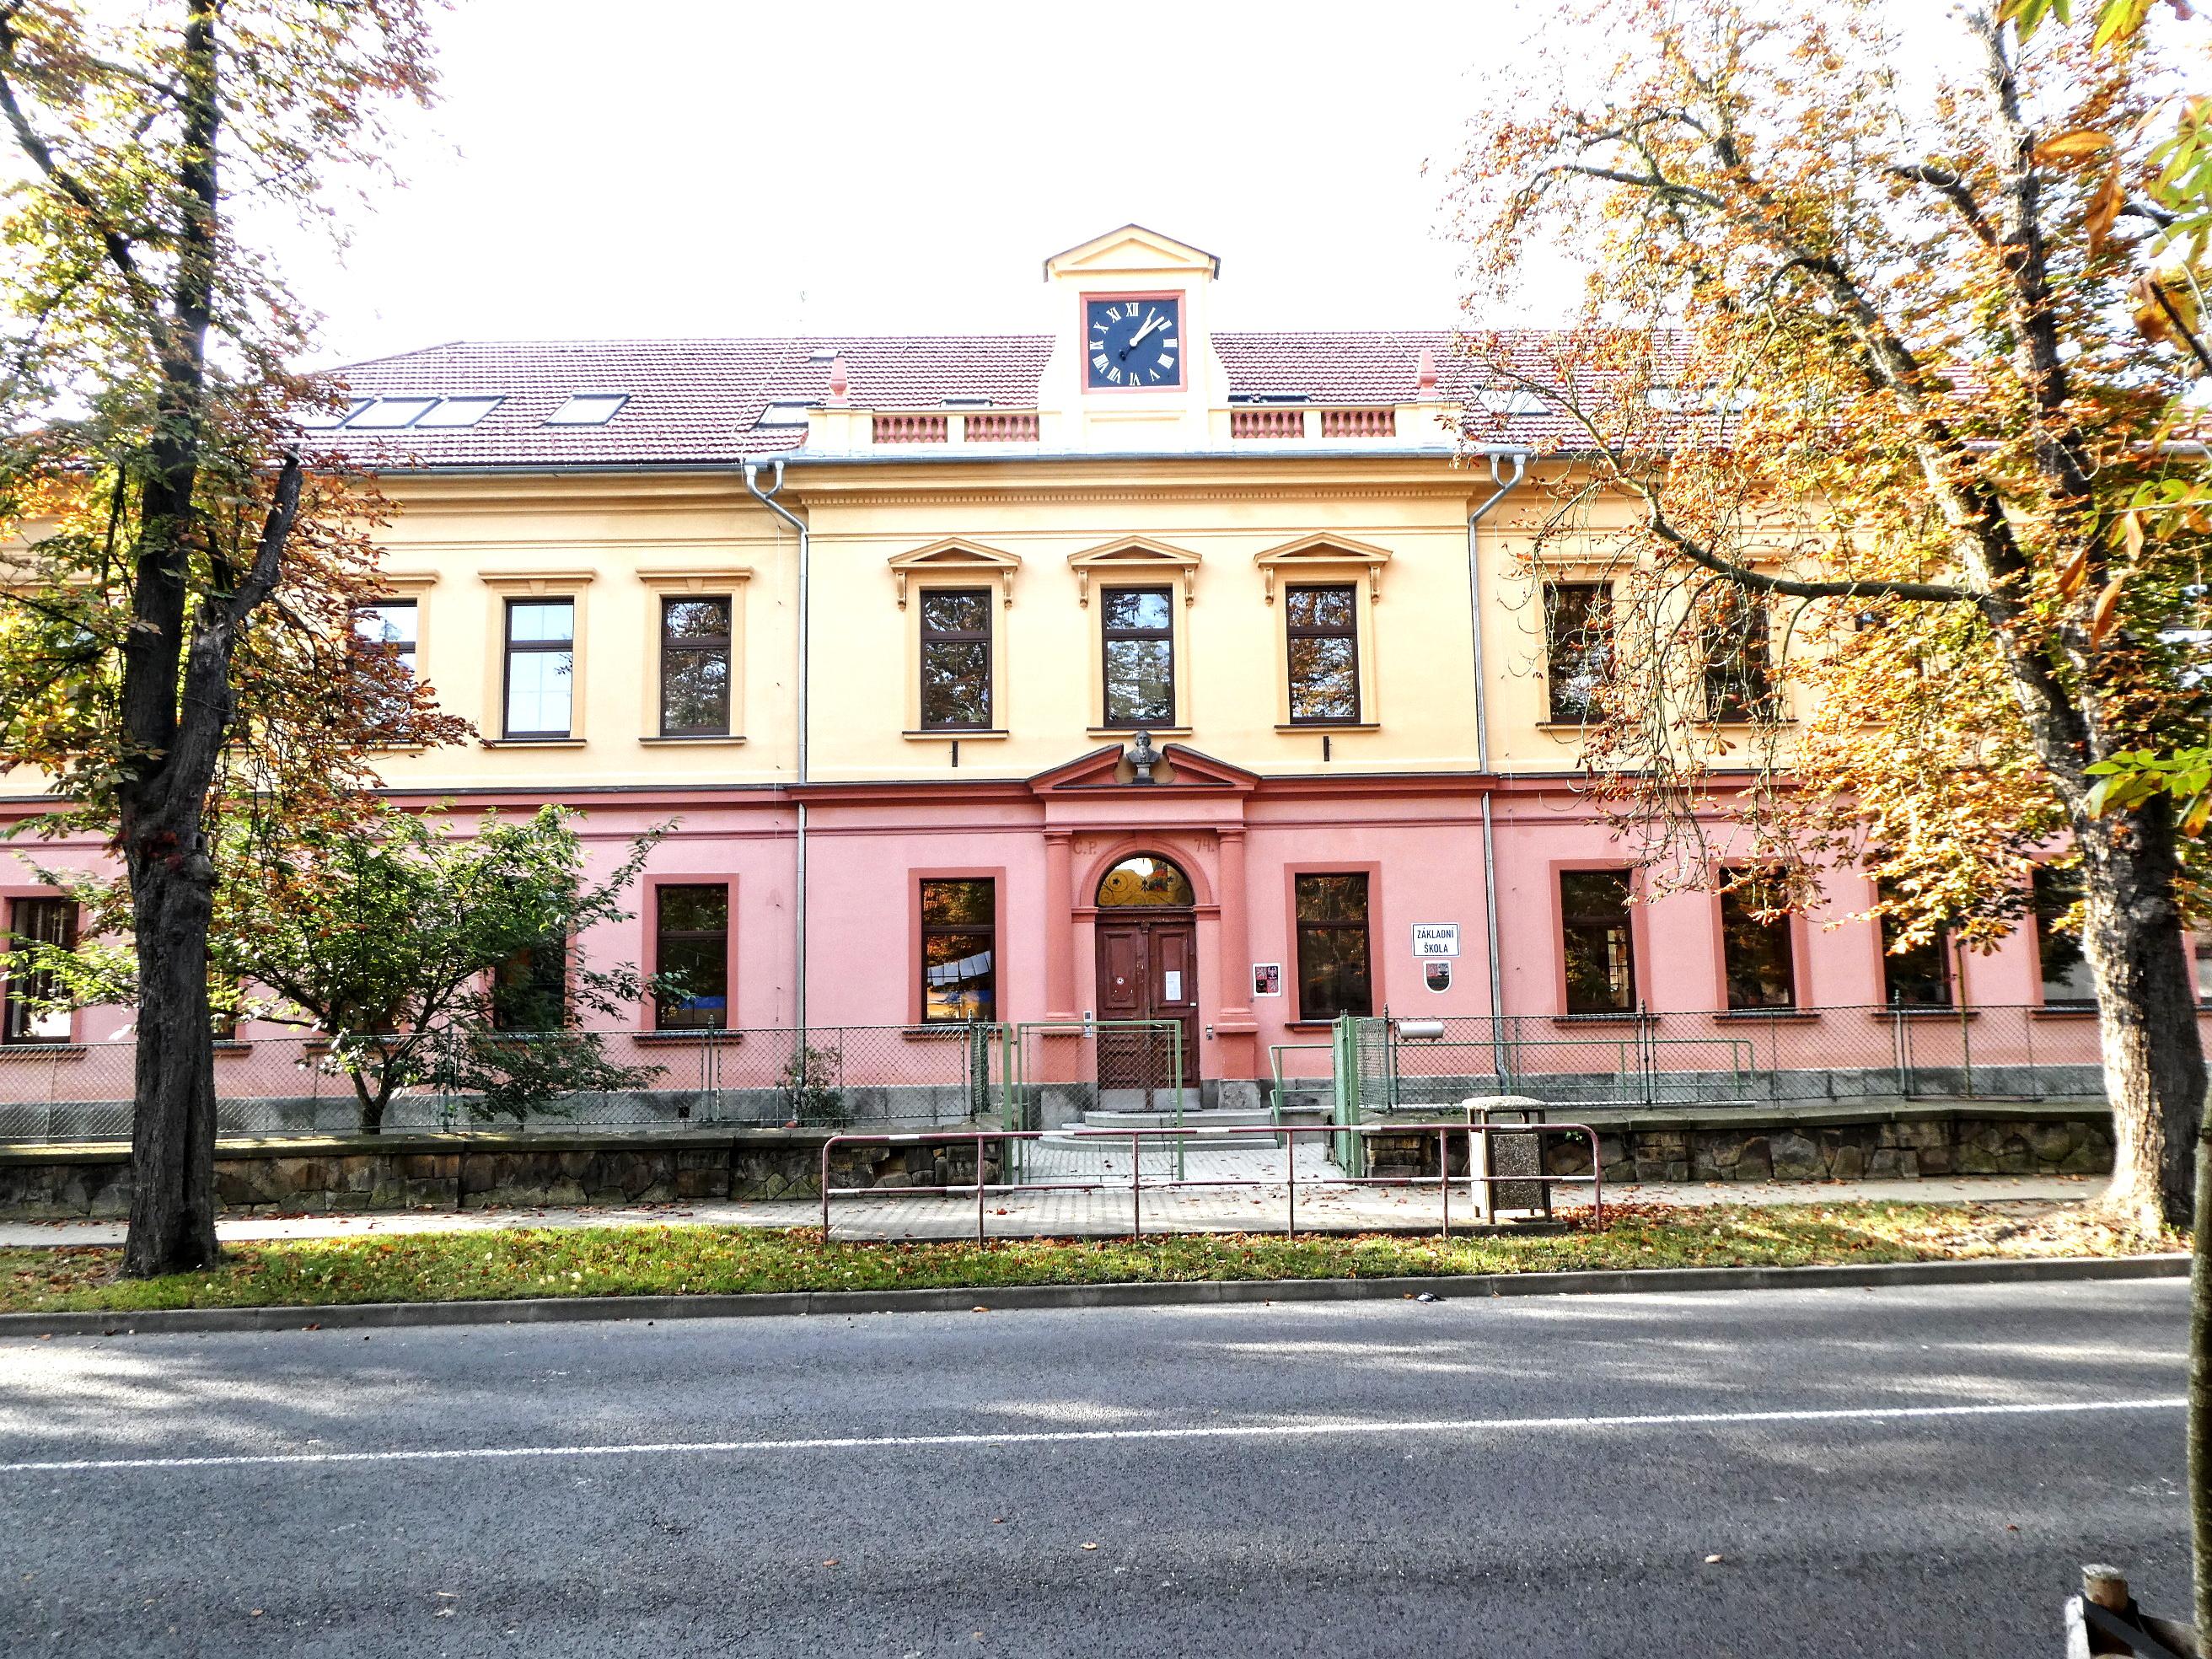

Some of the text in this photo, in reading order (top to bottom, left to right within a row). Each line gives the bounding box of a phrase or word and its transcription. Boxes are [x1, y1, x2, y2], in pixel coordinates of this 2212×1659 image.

[1106, 307, 1121, 323] XI
[1125, 303, 1139, 317] XII
[1093, 321, 1109, 334] X
[1157, 319, 1173, 331] II
[1090, 340, 1103, 350] IX
[1163, 338, 1178, 347] III
[1107, 366, 1121, 384] VII
[1130, 372, 1141, 385] VI
[1149, 368, 1160, 381] V
[1417, 927, 1454, 938] ZÁKLADNÍ
[1424, 942, 1448, 953] ŠKOLA
